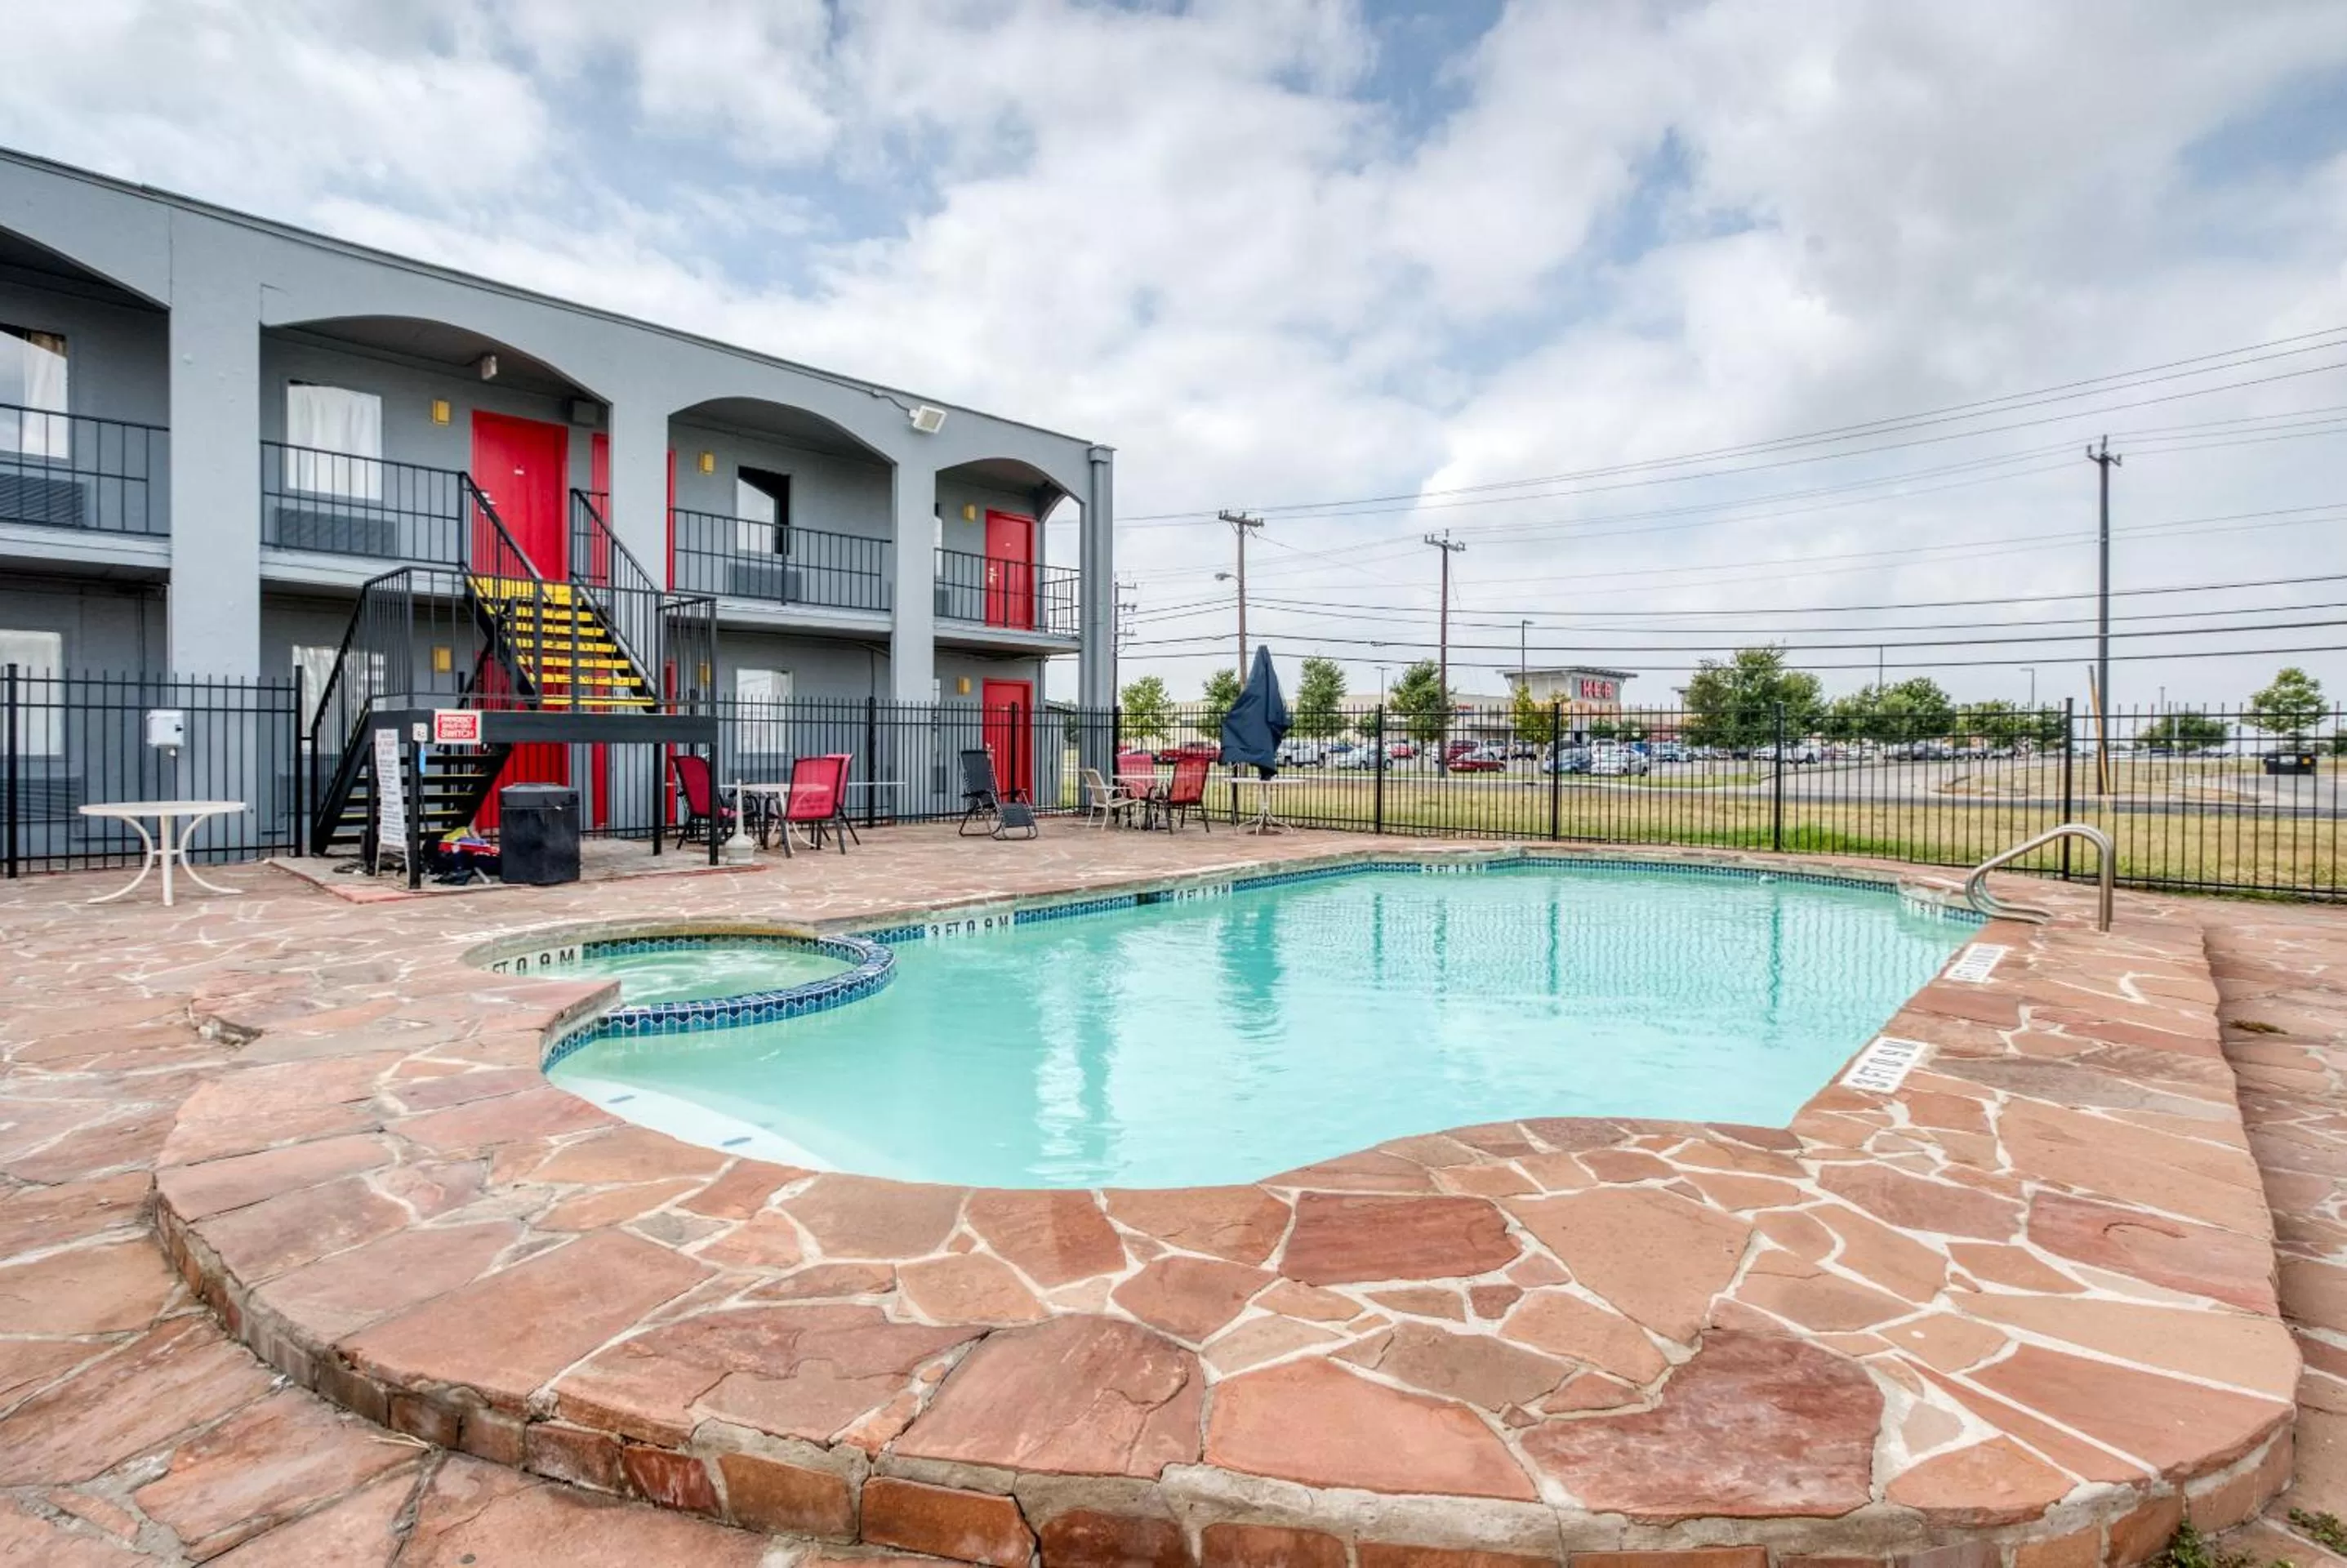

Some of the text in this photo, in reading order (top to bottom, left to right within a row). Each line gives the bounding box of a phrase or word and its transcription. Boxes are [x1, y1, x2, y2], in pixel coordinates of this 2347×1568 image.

[1187, 888, 1197, 900] FT
[946, 921, 960, 936] FT
[998, 914, 1009, 926] M
[559, 947, 575, 963] M
